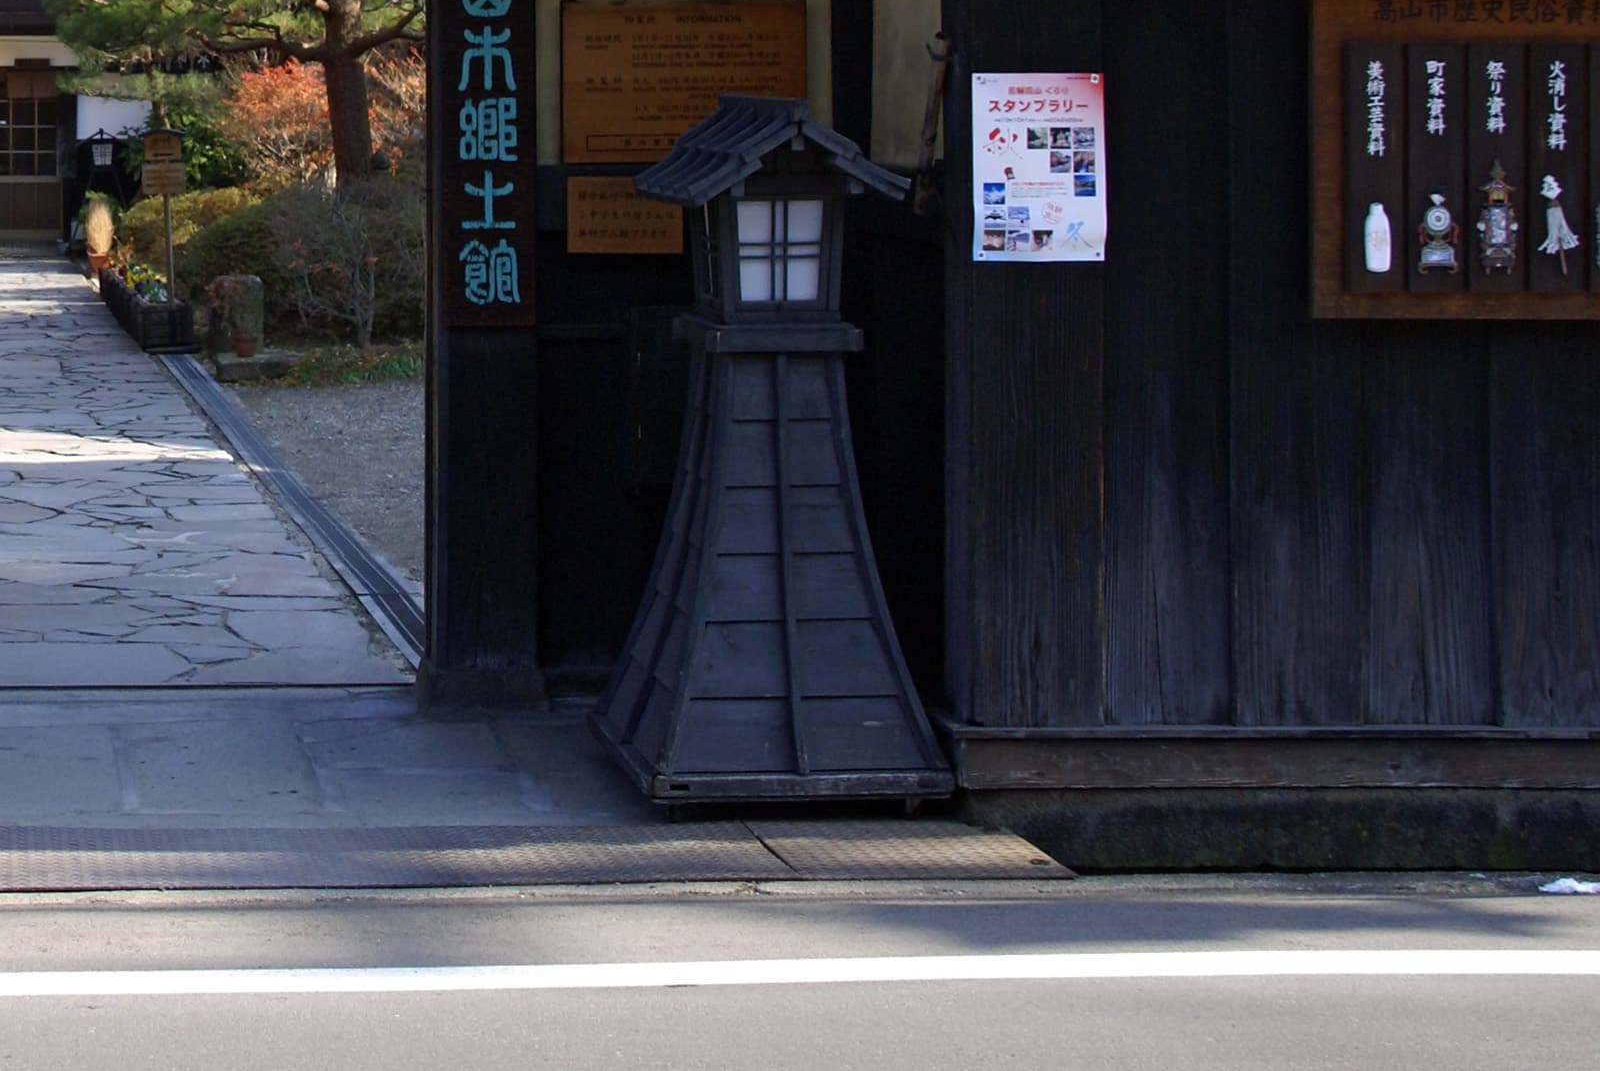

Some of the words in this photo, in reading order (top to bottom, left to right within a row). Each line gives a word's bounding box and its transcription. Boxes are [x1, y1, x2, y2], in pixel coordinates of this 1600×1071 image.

[988, 99, 1089, 114] スタンプラリー
[1425, 60, 1446, 135] 町家資料
[1486, 60, 1506, 134] 祭り資料
[1547, 60, 1567, 150] 火消し資料
